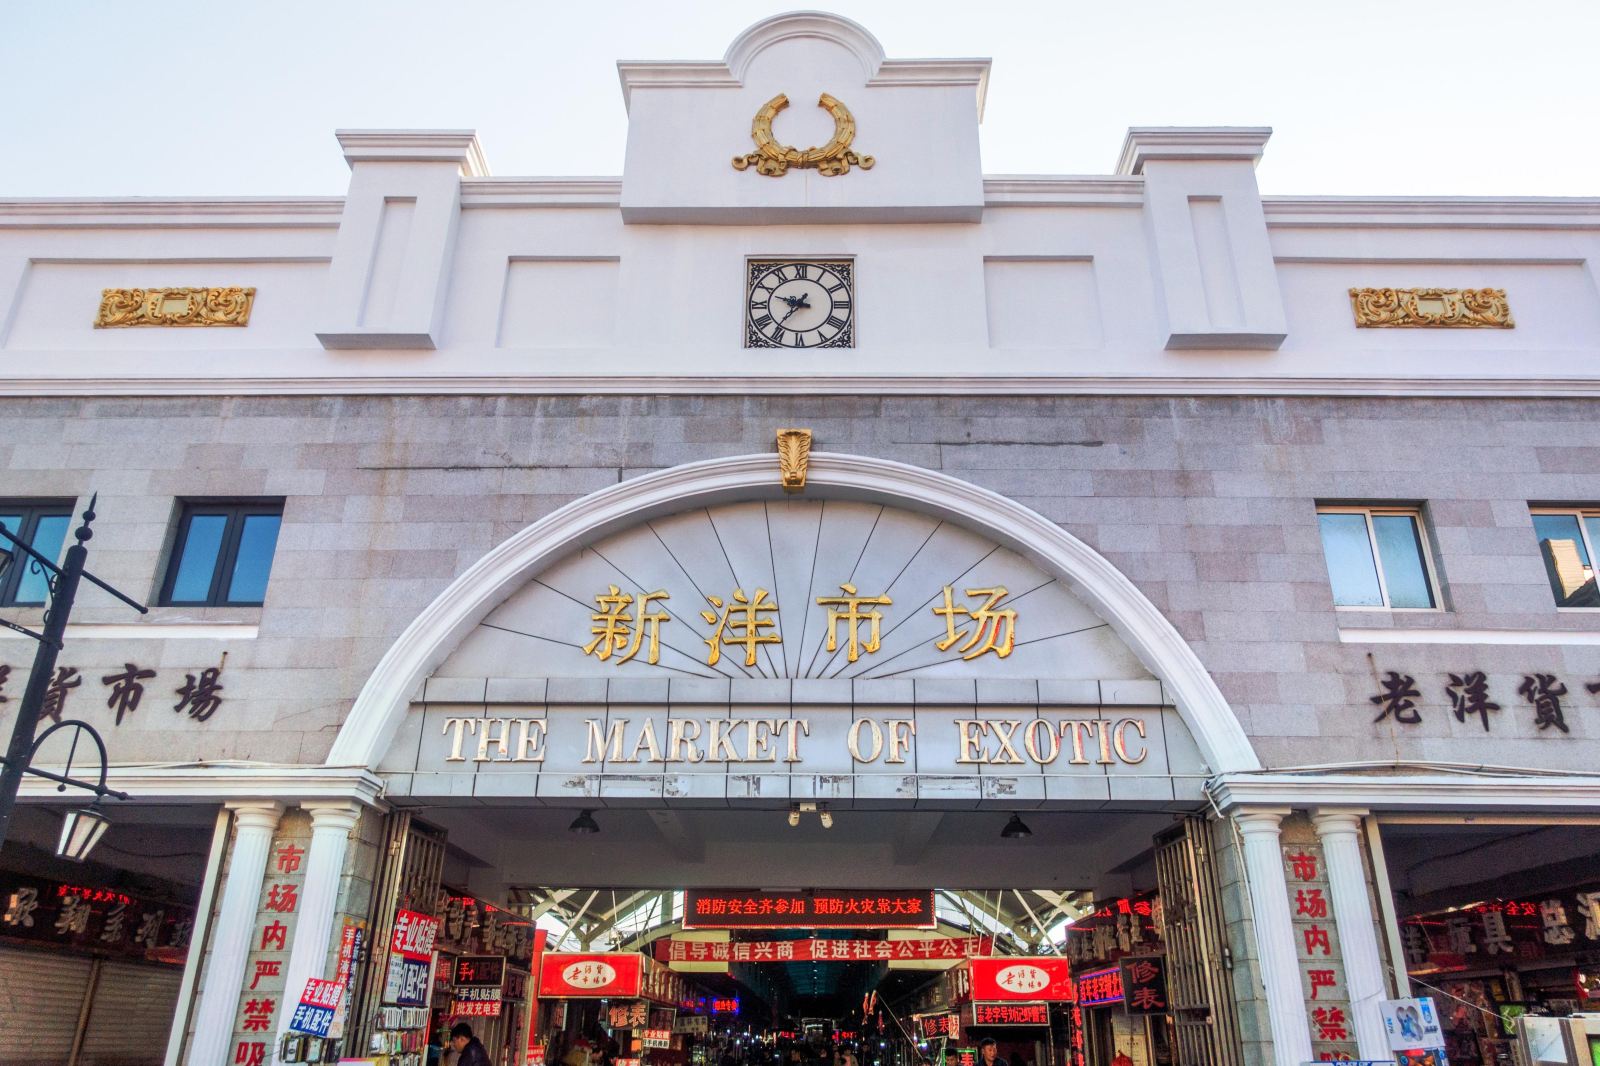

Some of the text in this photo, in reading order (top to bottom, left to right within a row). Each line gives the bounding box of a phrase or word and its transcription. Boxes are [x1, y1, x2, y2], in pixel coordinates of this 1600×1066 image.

[582, 585, 1018, 667] 新洋市场
[1370, 671, 1600, 733] 老洋貨
[443, 717, 1147, 765] THE MARKET OF EXOTIC
[696, 898, 922, 914] 消防安全齐参加 预防火灾靠大家
[394, 914, 438, 955] 专业贴膜
[669, 938, 979, 960] 倡导诚信兴商 促进社会公平公正
[235, 845, 304, 1066] 市场内严禁吸
[301, 979, 344, 1007] 专业贴膜
[459, 988, 501, 1000] 手机贴膜
[1125, 962, 1165, 1009] 修表
[293, 1005, 333, 1034] 手机配件
[456, 1002, 501, 1015] 批发充电宝
[609, 1004, 645, 1027] 修表
